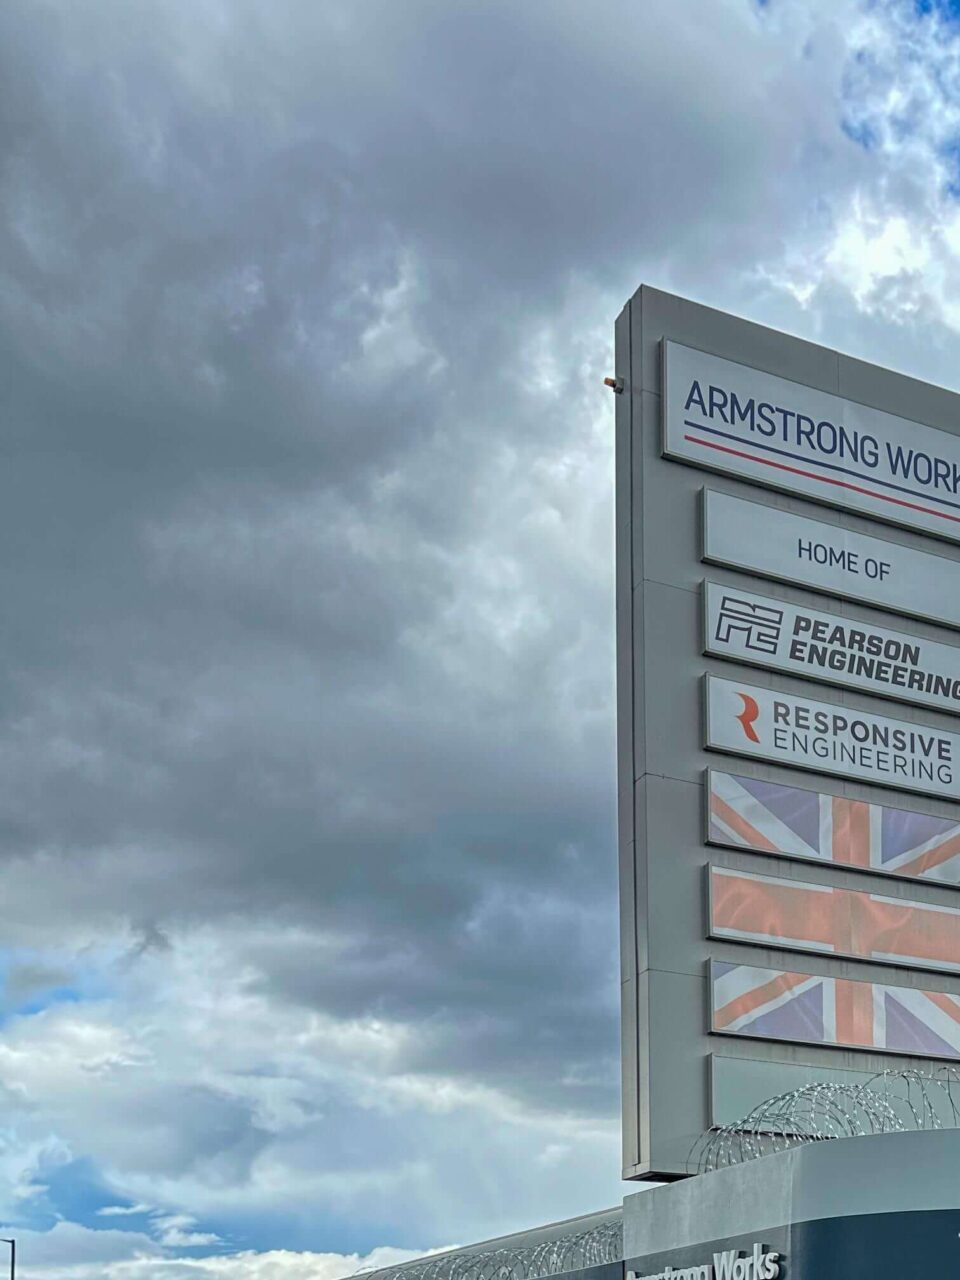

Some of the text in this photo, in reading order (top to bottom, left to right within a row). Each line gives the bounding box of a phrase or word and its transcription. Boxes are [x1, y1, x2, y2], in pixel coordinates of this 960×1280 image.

[684, 379, 879, 468] ARMSTRONG
[798, 538, 891, 581] HOME OF
[792, 615, 921, 666] PEARSON
[773, 700, 952, 762] RESPONSIVE
[774, 727, 953, 785] ENGINEERING
